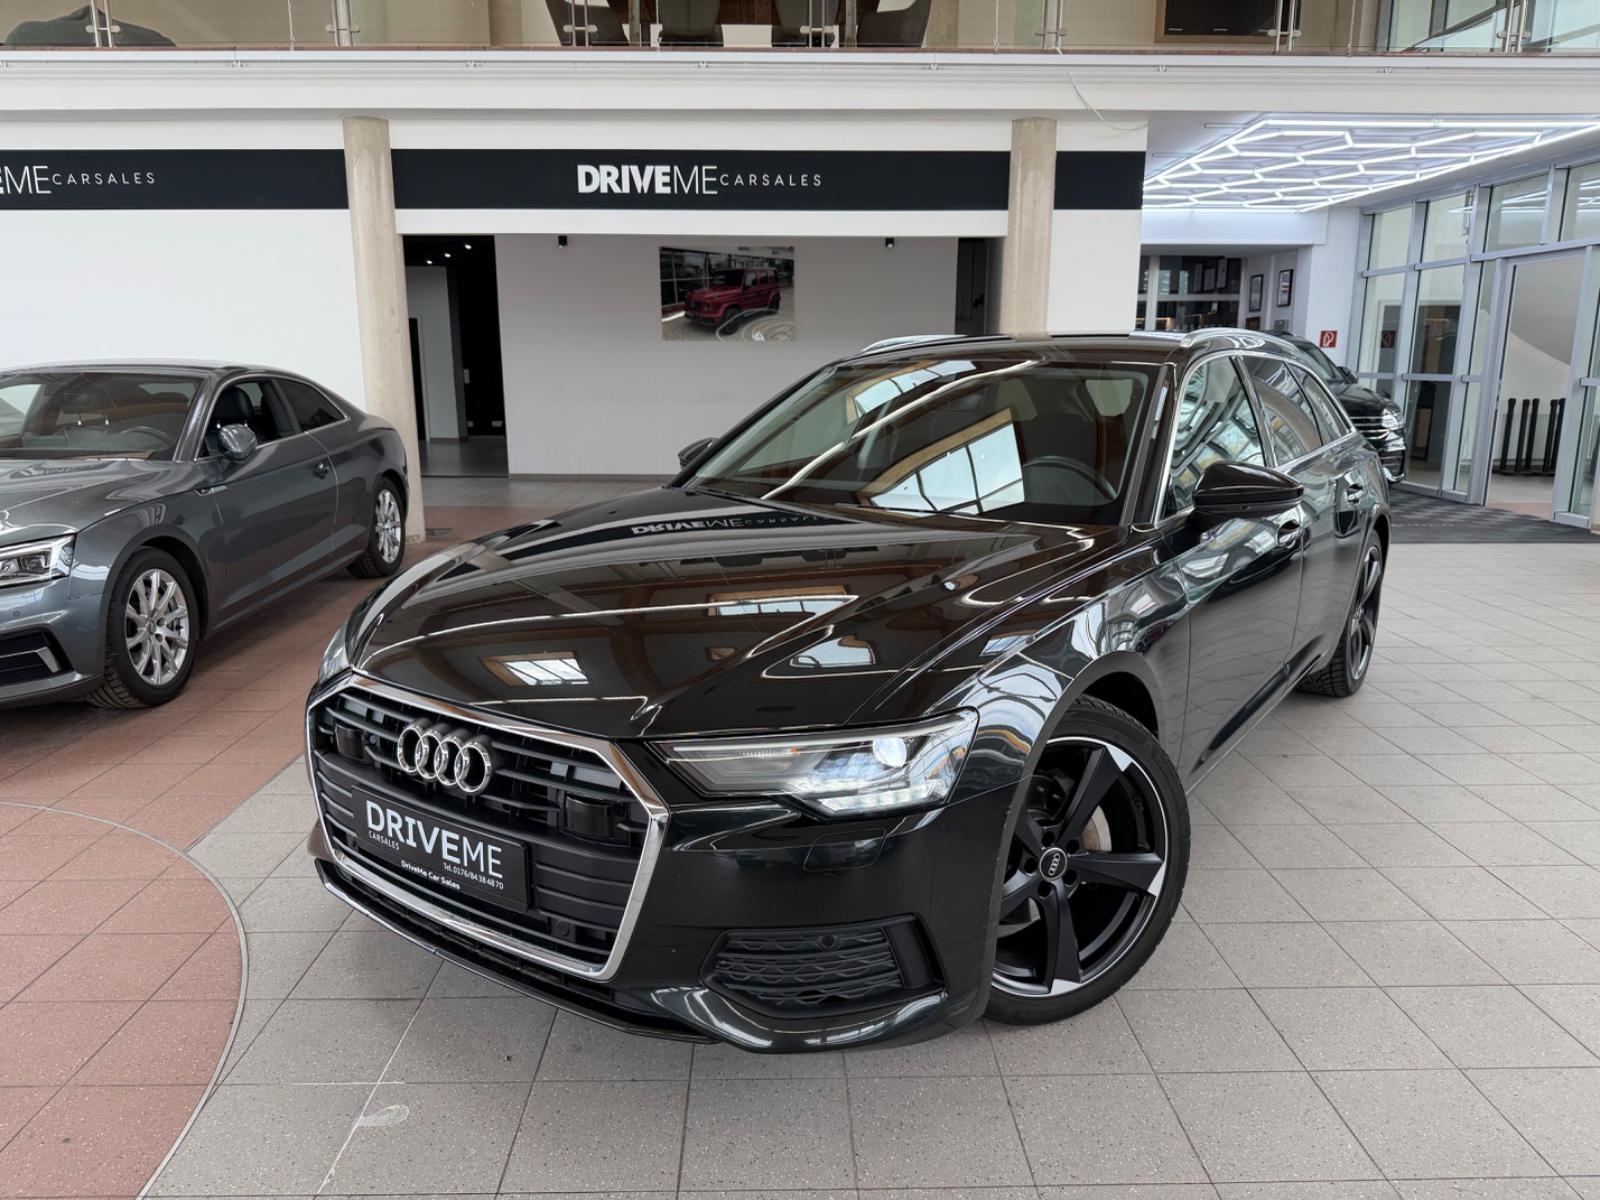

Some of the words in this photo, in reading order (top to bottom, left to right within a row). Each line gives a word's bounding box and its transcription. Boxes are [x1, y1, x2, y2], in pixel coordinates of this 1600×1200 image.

[0, 165, 52, 195] ME
[52, 172, 156, 186] CARSALES
[577, 164, 718, 195] DRIVEME
[719, 173, 822, 187] CARSALES
[366, 799, 503, 879] DRIVEME
[368, 829, 400, 850] CARSALES
[428, 871, 440, 882] Car
[440, 875, 461, 890] Sales
